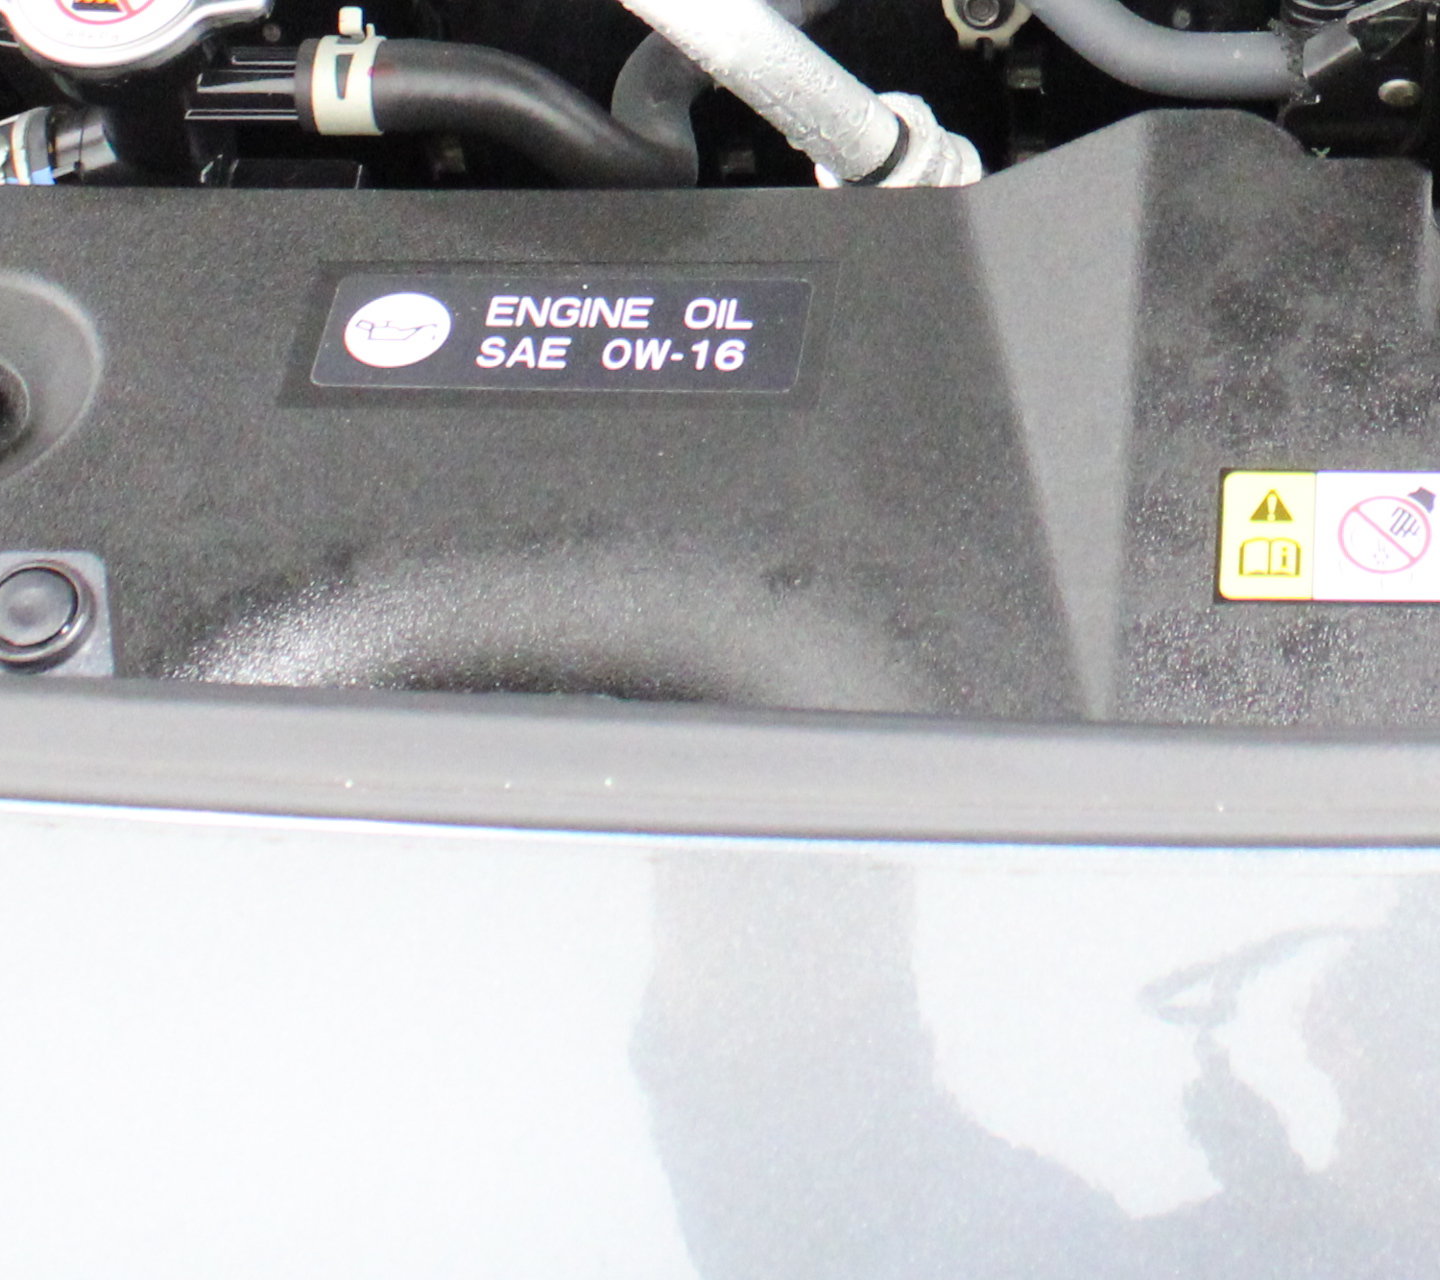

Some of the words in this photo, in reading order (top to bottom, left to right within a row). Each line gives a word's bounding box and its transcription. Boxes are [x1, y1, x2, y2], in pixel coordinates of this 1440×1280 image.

[484, 295, 655, 331] ENGINE
[682, 296, 754, 331] OIL
[474, 336, 572, 371] SAE
[600, 337, 746, 372] 0W-16
